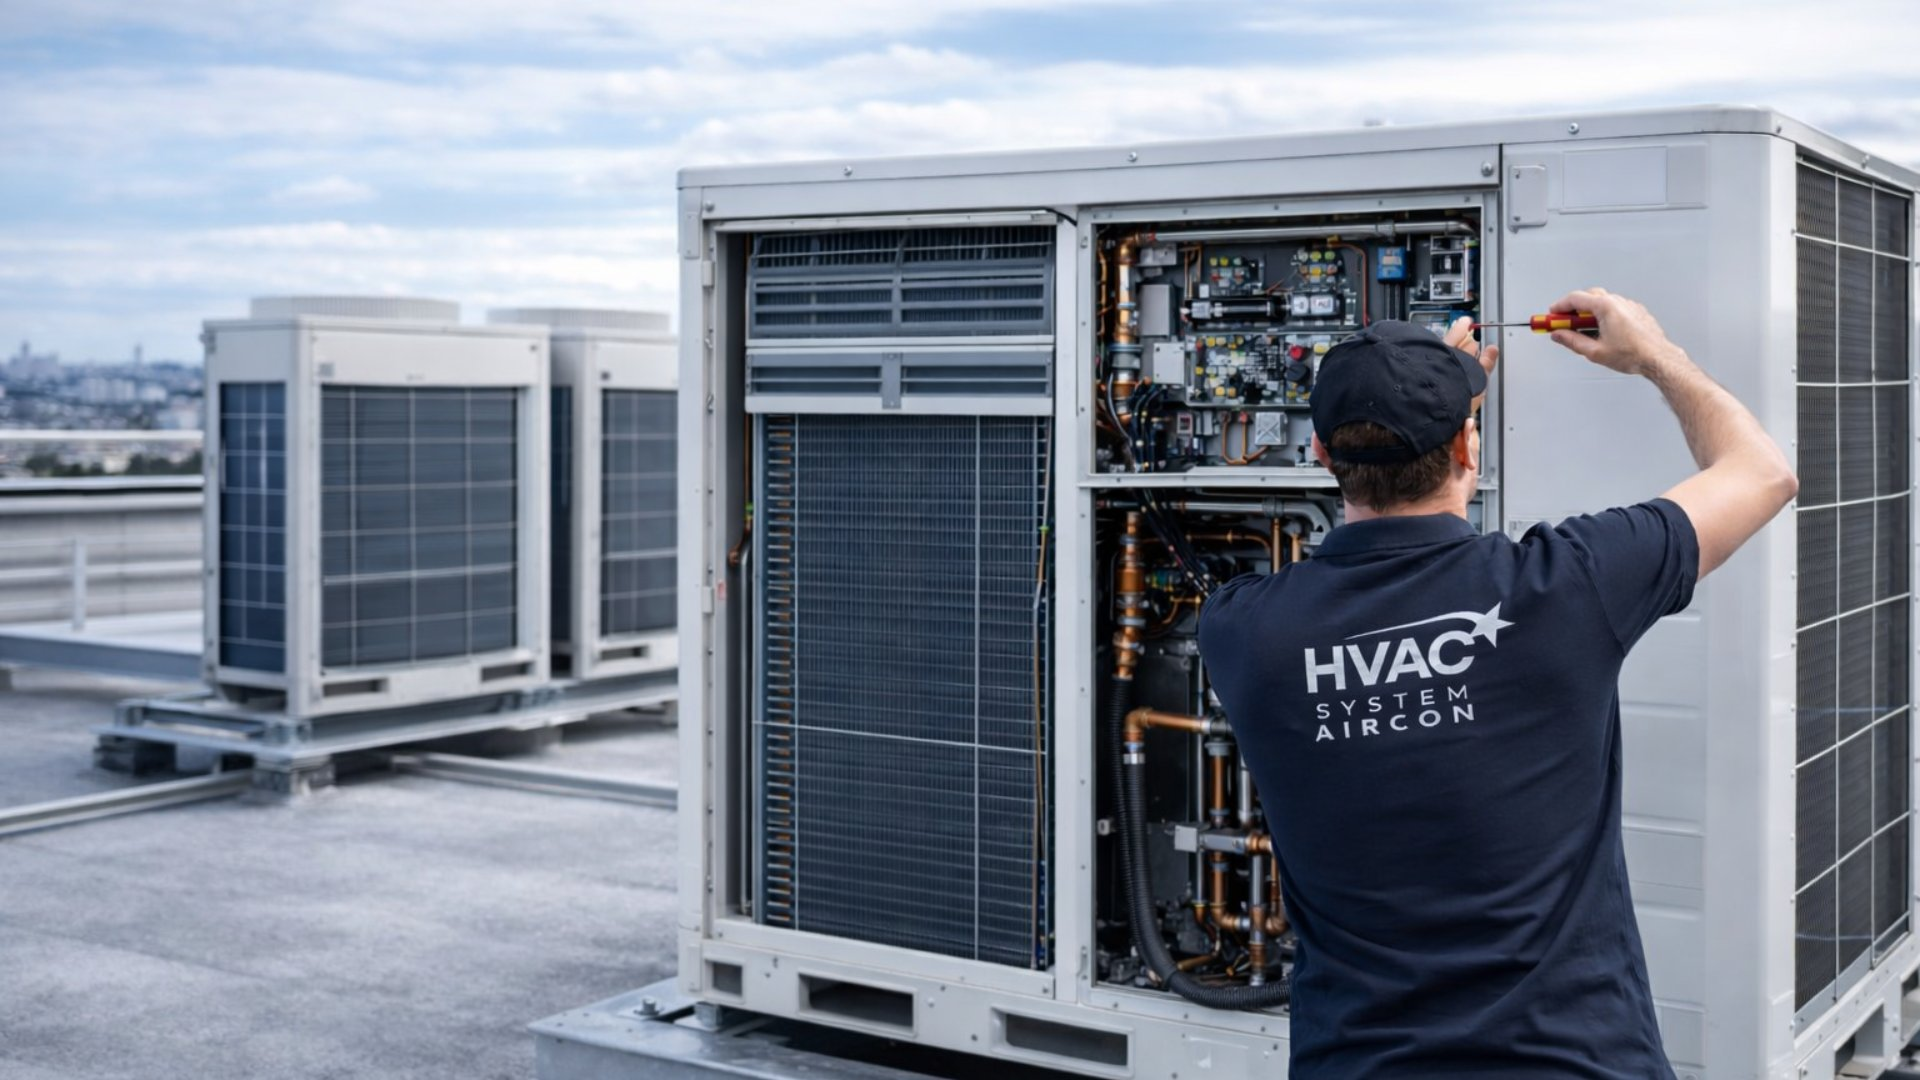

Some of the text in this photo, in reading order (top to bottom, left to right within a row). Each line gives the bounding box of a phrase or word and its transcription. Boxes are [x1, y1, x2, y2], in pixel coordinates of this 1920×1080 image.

[1304, 630, 1475, 693] HVAC
[1316, 685, 1468, 719] SYSTEM
[1316, 704, 1474, 742] AIRCON
